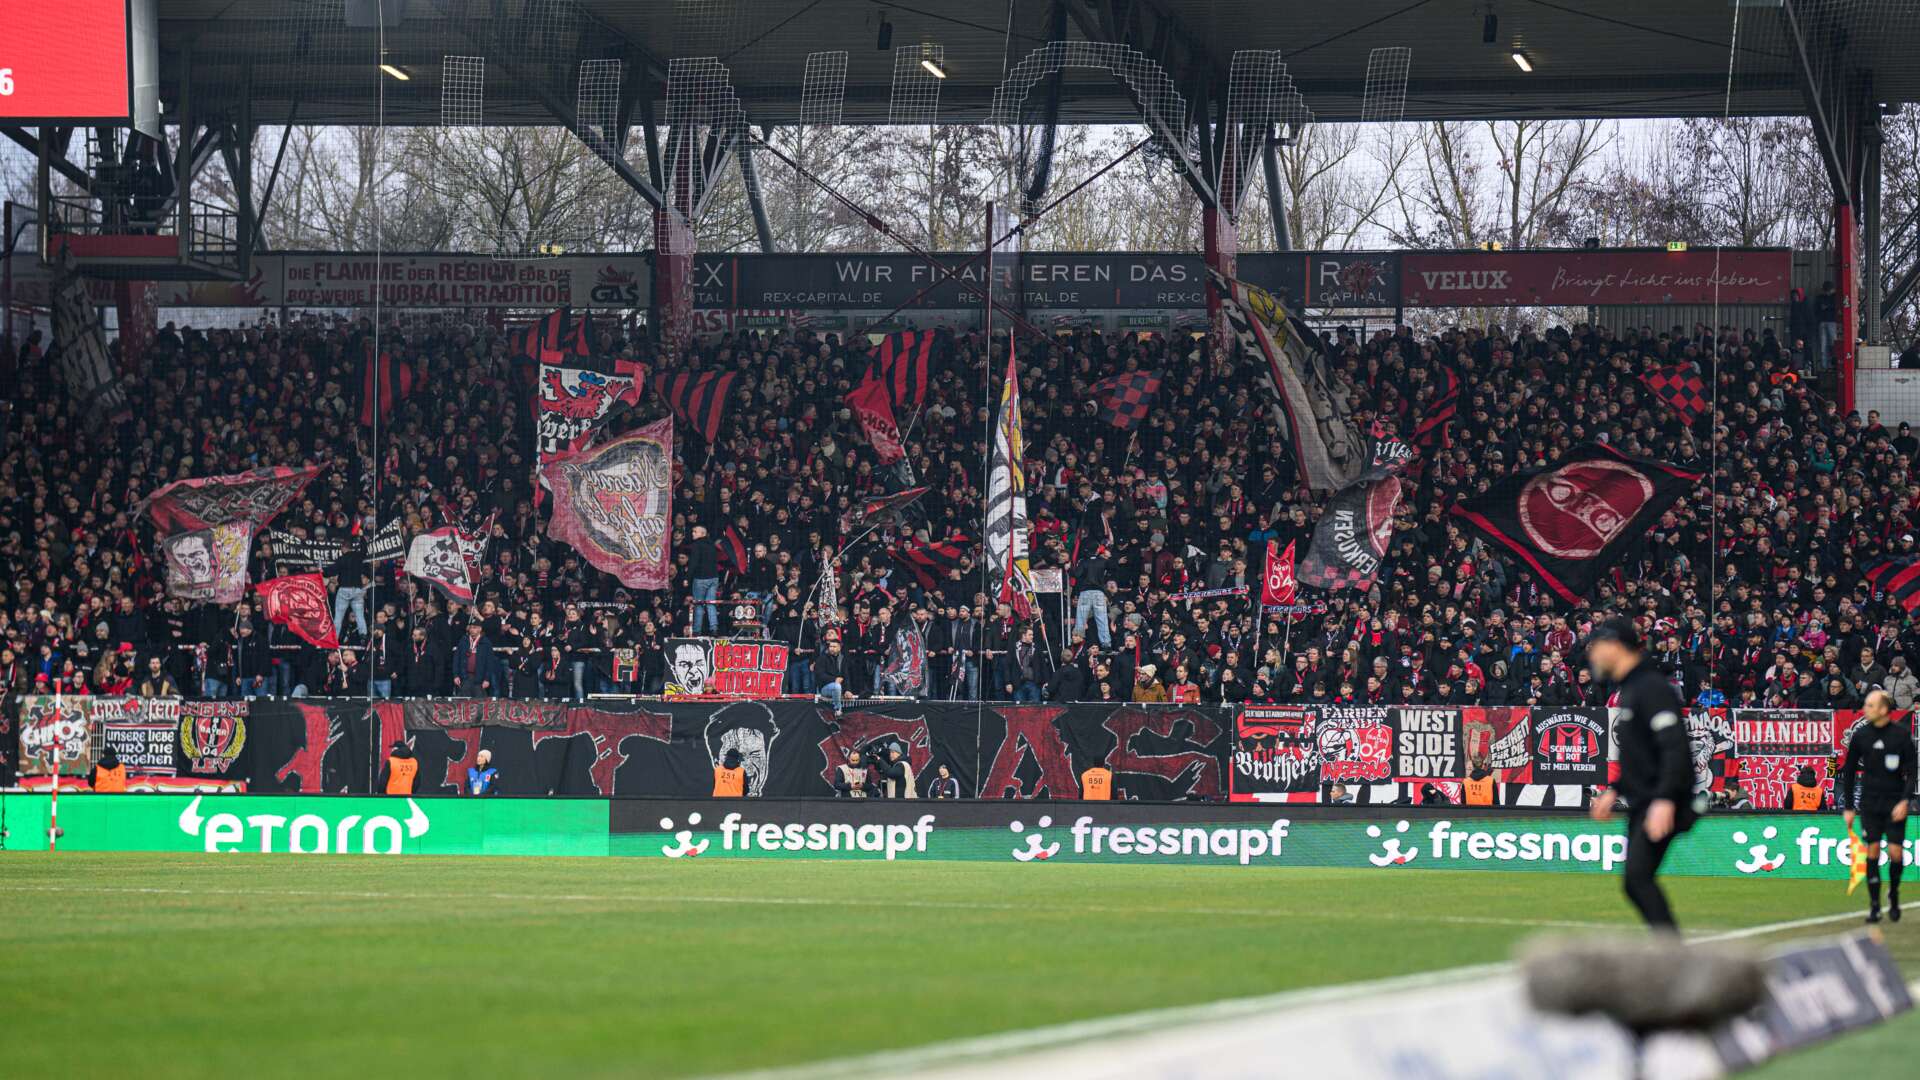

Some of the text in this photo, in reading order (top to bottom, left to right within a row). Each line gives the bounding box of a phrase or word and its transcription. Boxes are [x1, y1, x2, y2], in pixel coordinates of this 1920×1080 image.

[0, 68, 14, 96] 6
[289, 267, 310, 280] DIE
[314, 262, 403, 281] FLAMME
[408, 268, 434, 281] DER
[439, 262, 516, 281] REGION
[836, 261, 892, 282] WIR
[1130, 264, 1198, 282] DAS.
[1421, 270, 1508, 290] VELUX
[1552, 266, 1771, 297] Bringt Licht ins Leben
[591, 285, 640, 304] GAS
[763, 292, 882, 303] REX-CAPITAL.DE
[1269, 574, 1293, 590] 04
[1322, 706, 1388, 719] FARBEN
[1401, 710, 1457, 732] WEST
[1327, 717, 1383, 729] STADT
[1535, 713, 1605, 736] AUSWÄRTS WIE HEIM
[1738, 720, 1832, 744] DJANGOS
[107, 729, 174, 743] UNSERE LIEBE
[1400, 732, 1456, 755] SIDE
[1490, 715, 1530, 754] FREIHEIT
[149, 743, 173, 753] NIE
[202, 747, 218, 756] 04
[1491, 741, 1526, 761] FÜR DIE
[1550, 745, 1588, 754] SCHWARZ
[1566, 752, 1581, 761] ROT
[116, 754, 173, 766] ERGEHEN
[191, 757, 232, 774] LEV
[1400, 755, 1455, 777] BOYZ
[1540, 763, 1551, 771] IST
[1572, 764, 1597, 772] VEREIN
[721, 771, 736, 780] 251
[1236, 750, 1318, 791] Brothers
[1088, 777, 1103, 785] 850
[1470, 783, 1482, 792] 111
[720, 812, 935, 861] fressnapf
[1071, 816, 1291, 866] fressnapf
[1429, 820, 1627, 871] fressnap
